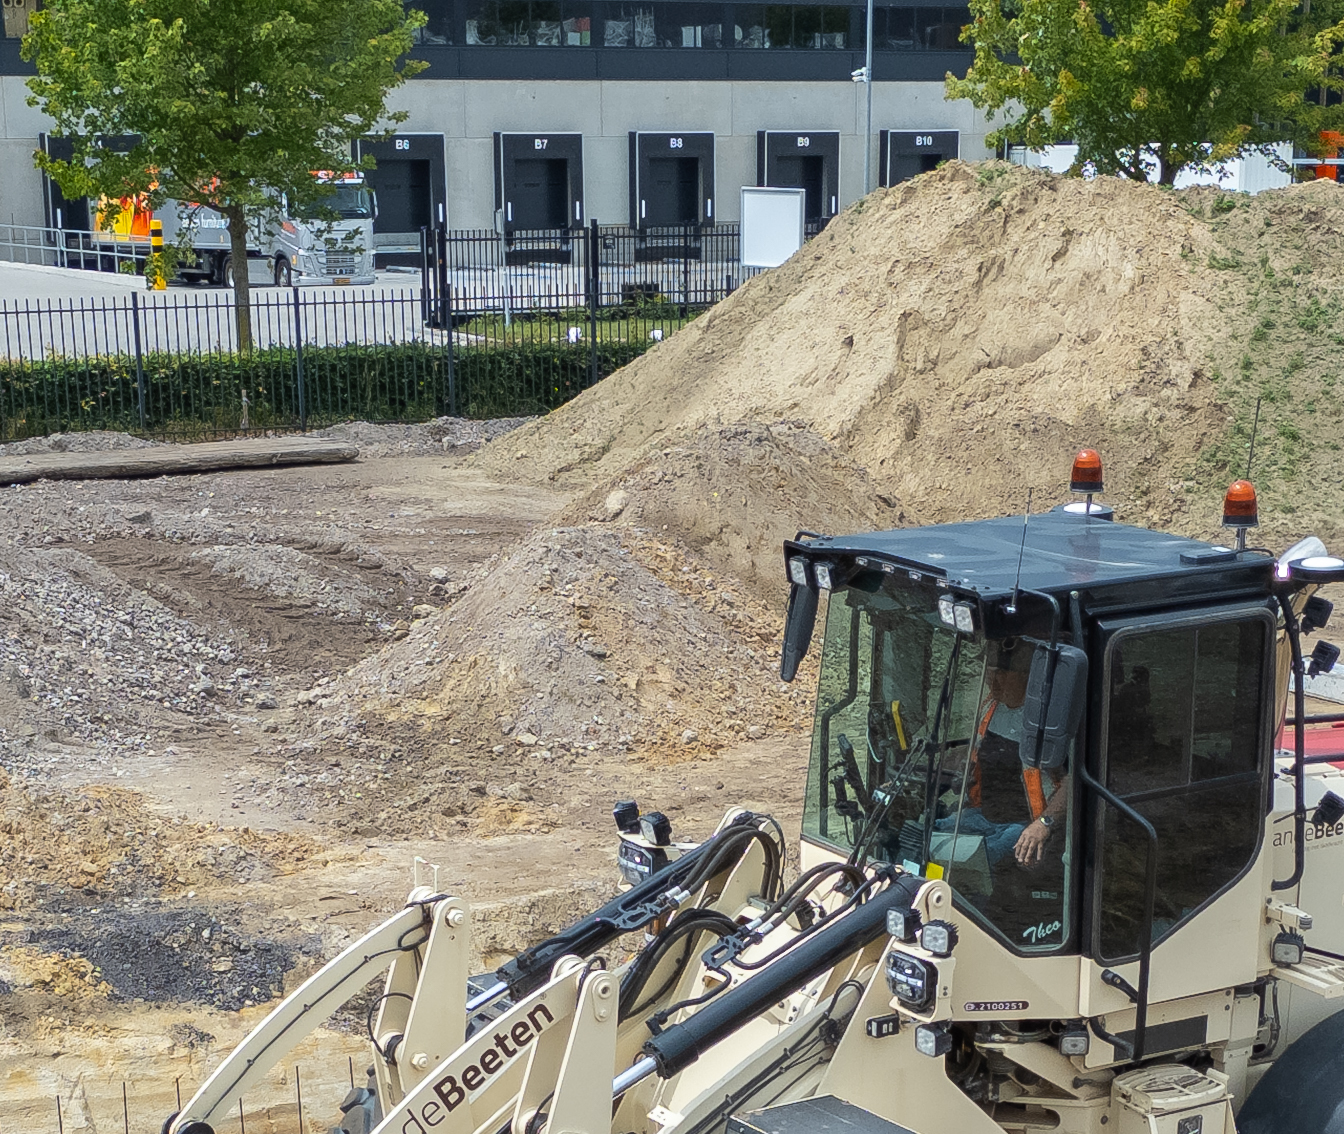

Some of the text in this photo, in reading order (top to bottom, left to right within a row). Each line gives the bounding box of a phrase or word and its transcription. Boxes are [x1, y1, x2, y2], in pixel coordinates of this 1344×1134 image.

[395, 139, 410, 150] B6
[534, 138, 548, 149] B7
[669, 137, 683, 148] B8
[797, 136, 810, 147] B9
[915, 135, 933, 146] B10
